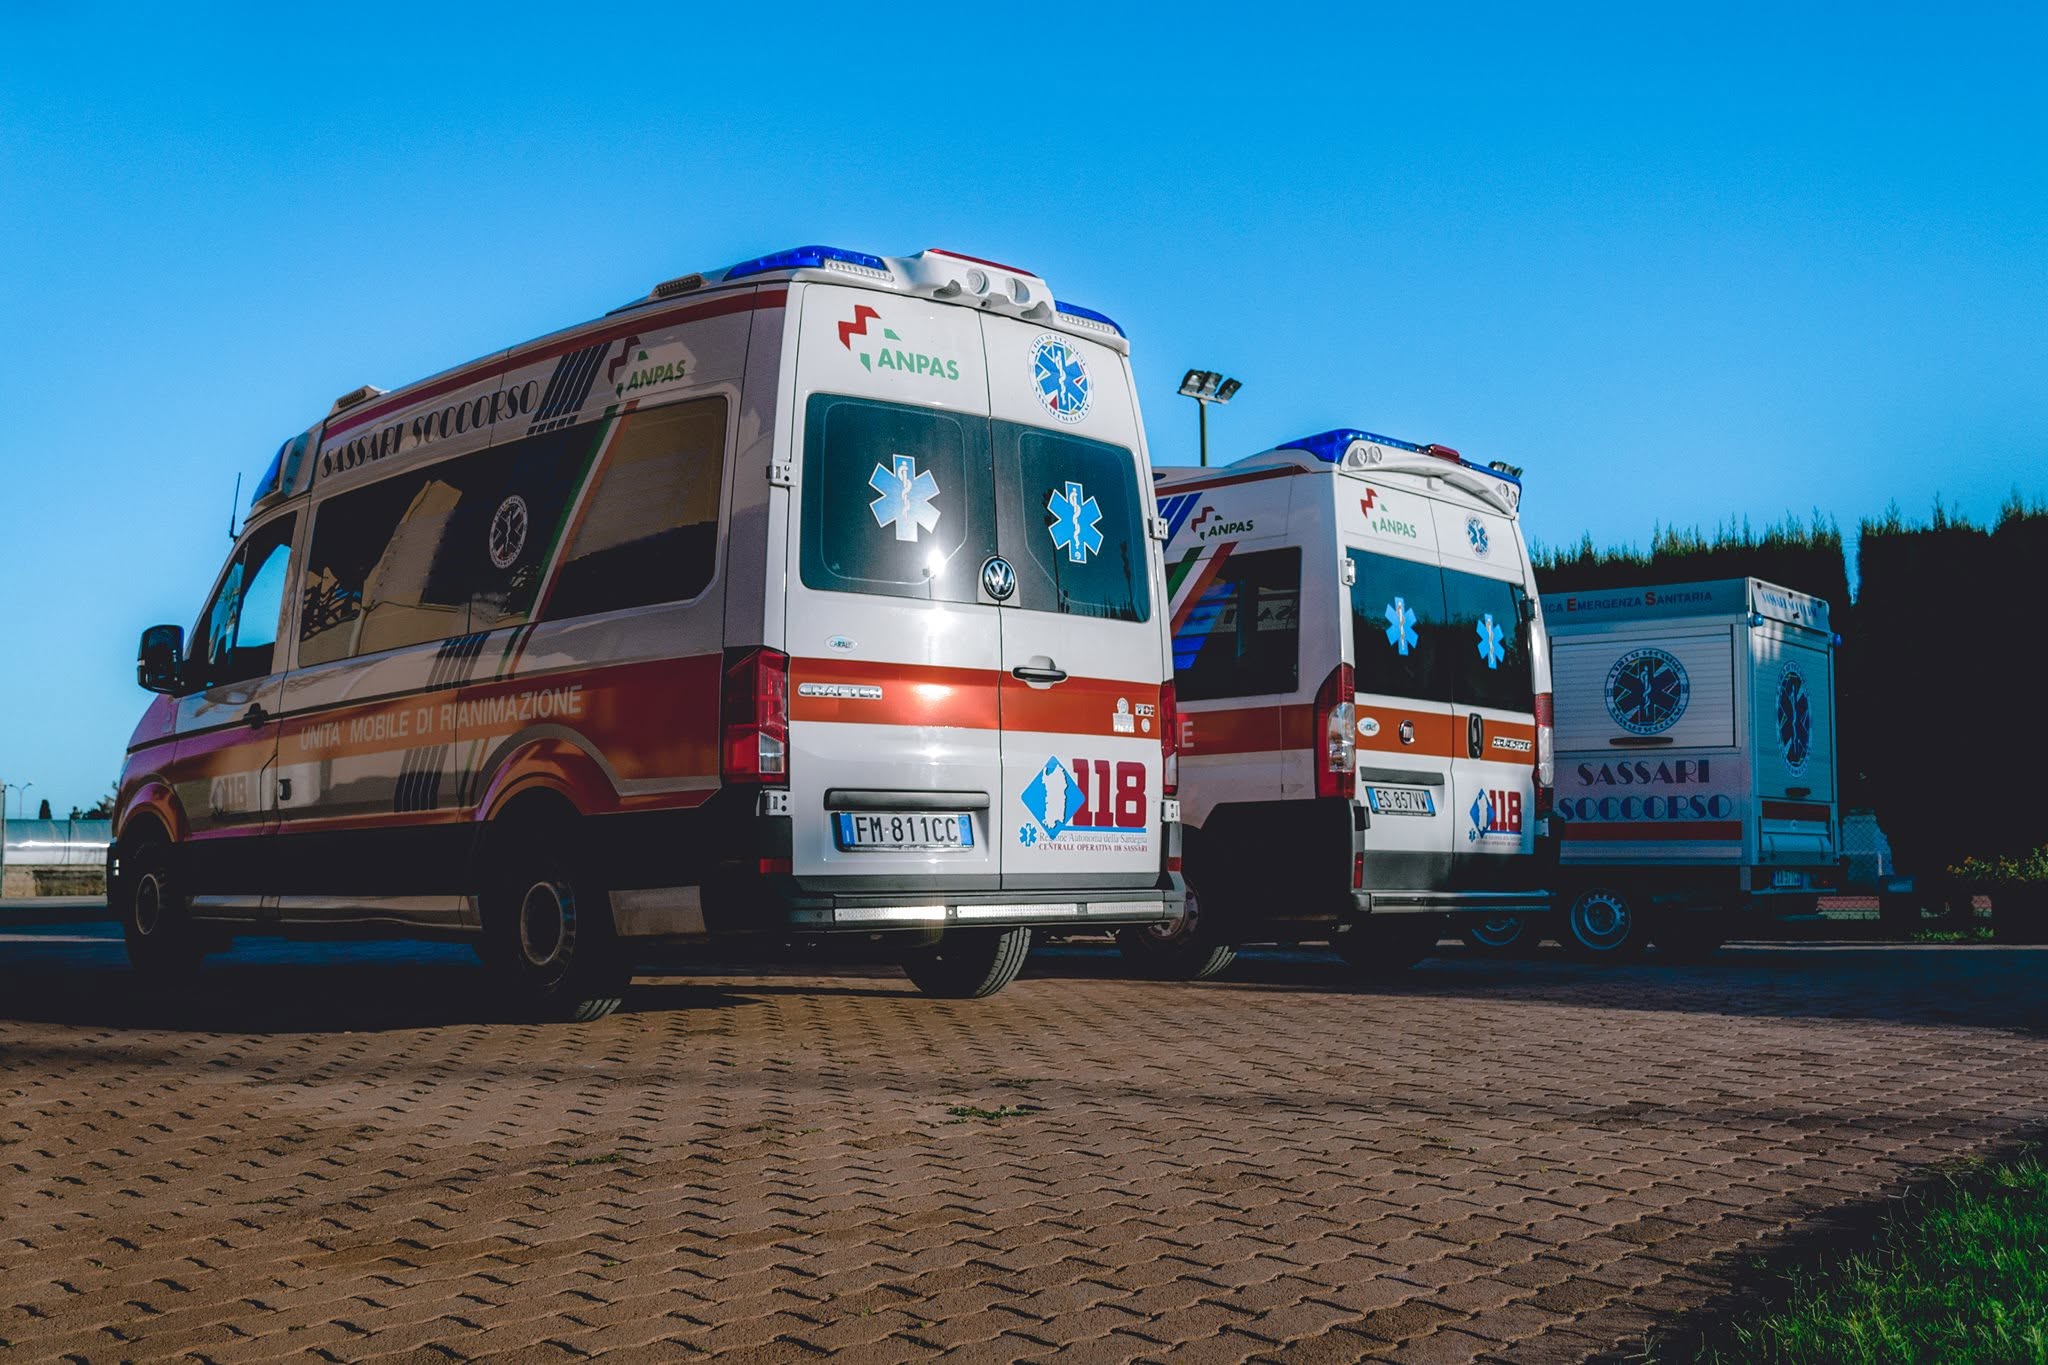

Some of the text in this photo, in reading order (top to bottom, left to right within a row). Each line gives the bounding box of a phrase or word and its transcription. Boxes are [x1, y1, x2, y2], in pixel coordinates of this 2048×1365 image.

[627, 360, 686, 391] ANPAS
[878, 348, 959, 380] ANPAS
[321, 380, 539, 478] SASSARI SOCCORSO
[1208, 520, 1254, 537] ANPAS
[1381, 518, 1417, 539] ANPAS
[1567, 597, 1642, 612] EMERGENZA
[1645, 591, 1713, 606] SANITARIA
[351, 711, 409, 741] MOBILE
[416, 707, 433, 734] DI
[440, 685, 583, 731] RIANIMAZIONE
[1578, 759, 1710, 786] SASSARI
[1072, 758, 1147, 828] 118
[1376, 790, 1392, 808] ES
[1558, 793, 1733, 821] SOCCORSO
[1489, 790, 1522, 832] 118
[1039, 843, 1074, 851] CENTRALE
[1077, 844, 1112, 852] OPERATIVA
[1123, 845, 1148, 853] SASSARI
